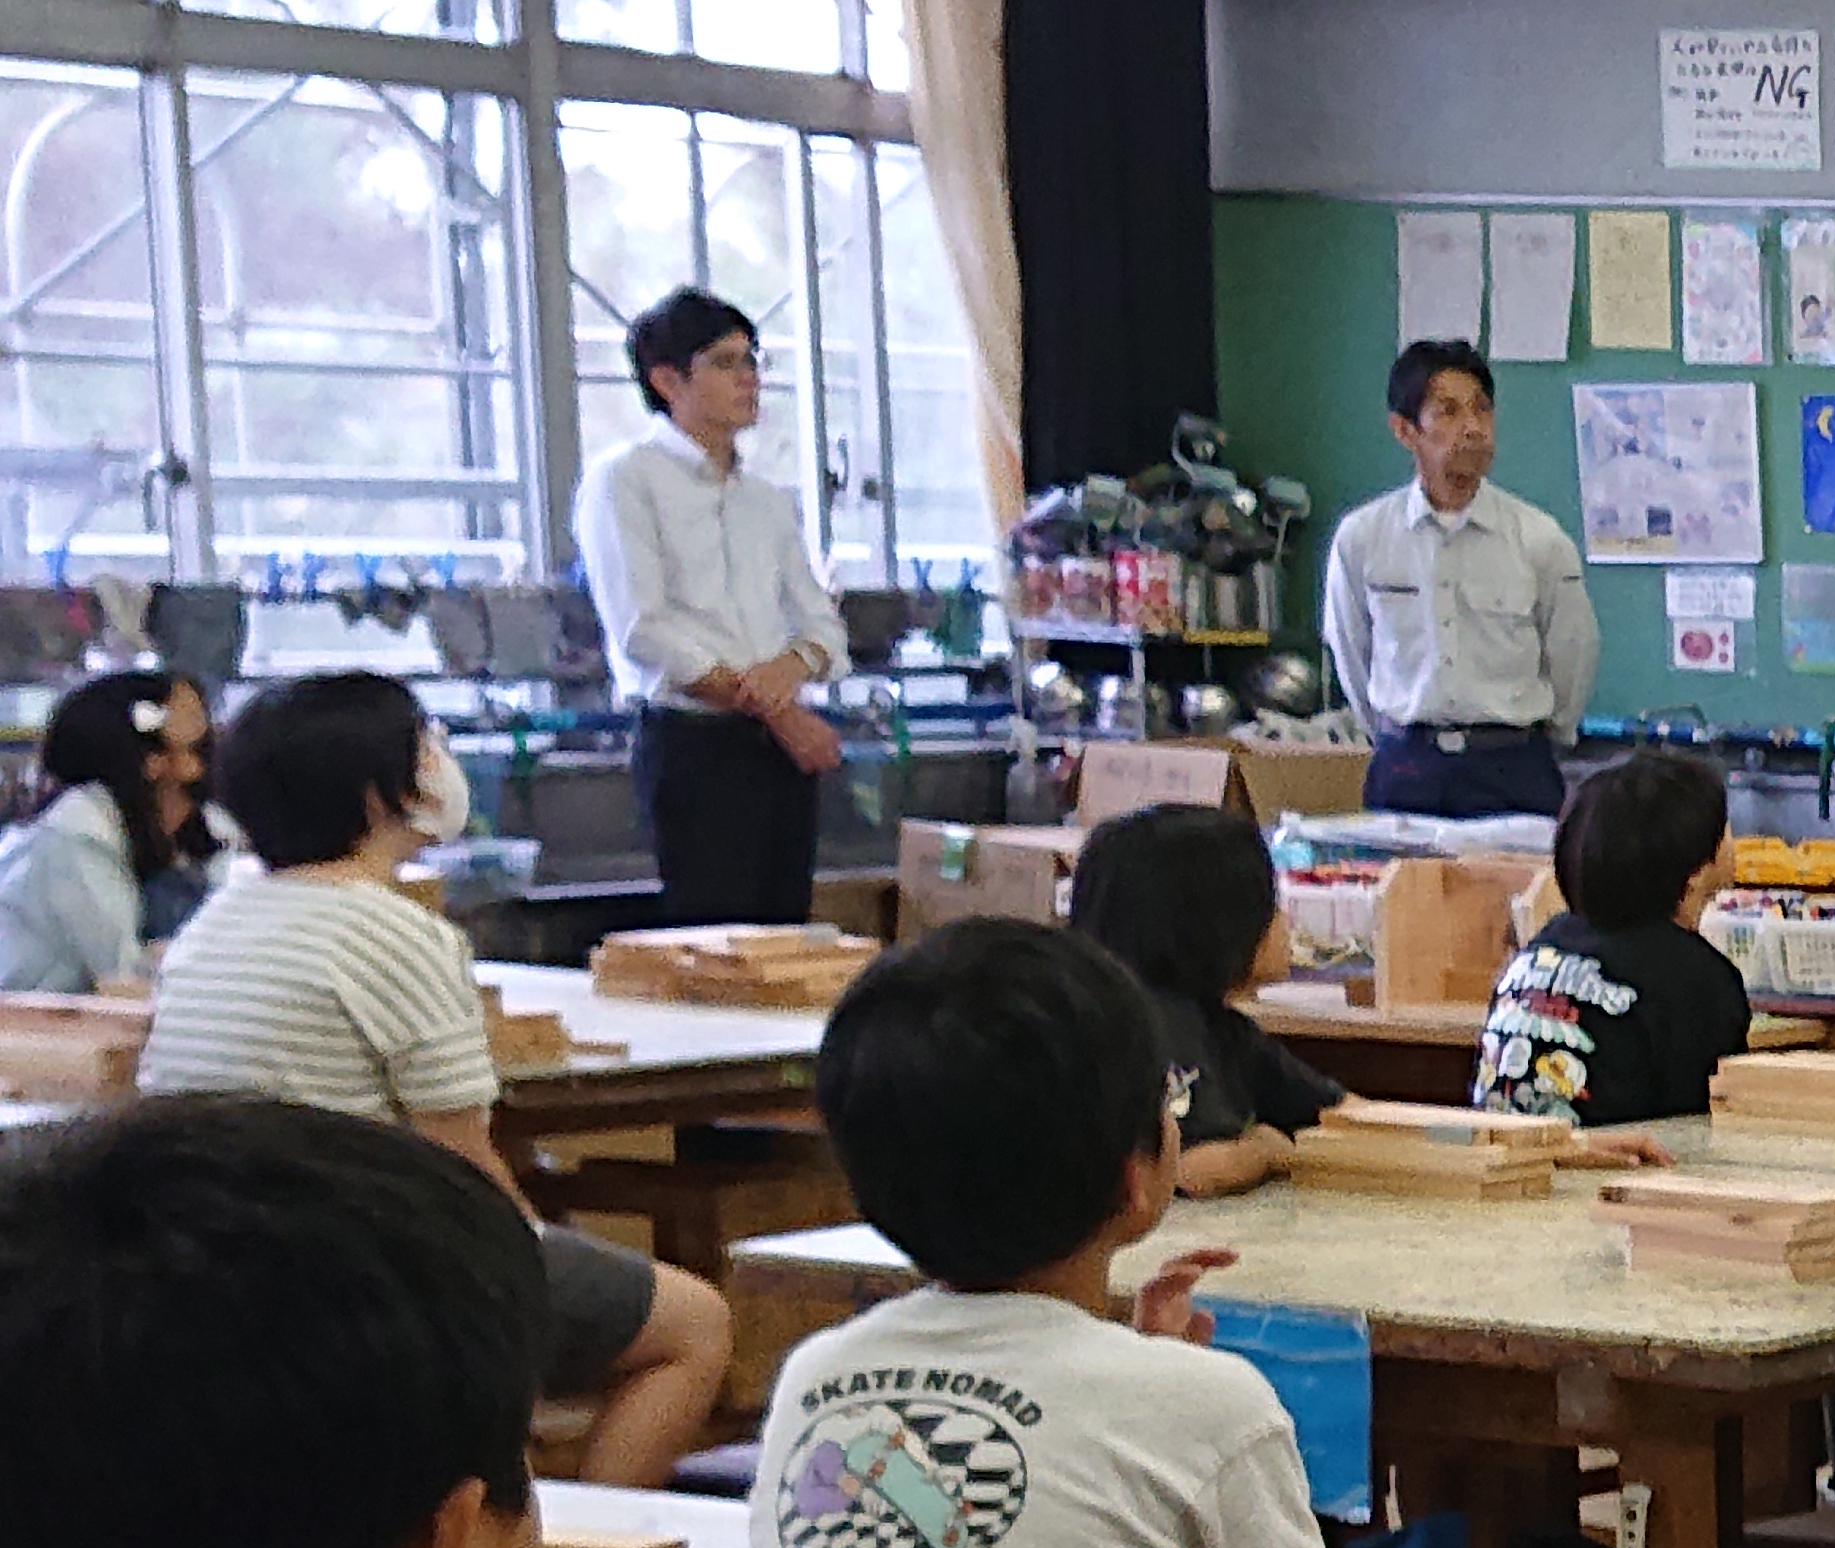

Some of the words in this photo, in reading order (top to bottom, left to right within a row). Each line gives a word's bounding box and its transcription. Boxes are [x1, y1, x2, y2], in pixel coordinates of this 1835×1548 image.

[1753, 64, 1811, 109] NG
[801, 1368, 916, 1414] SKATE
[923, 1368, 1043, 1427] NOMAD
